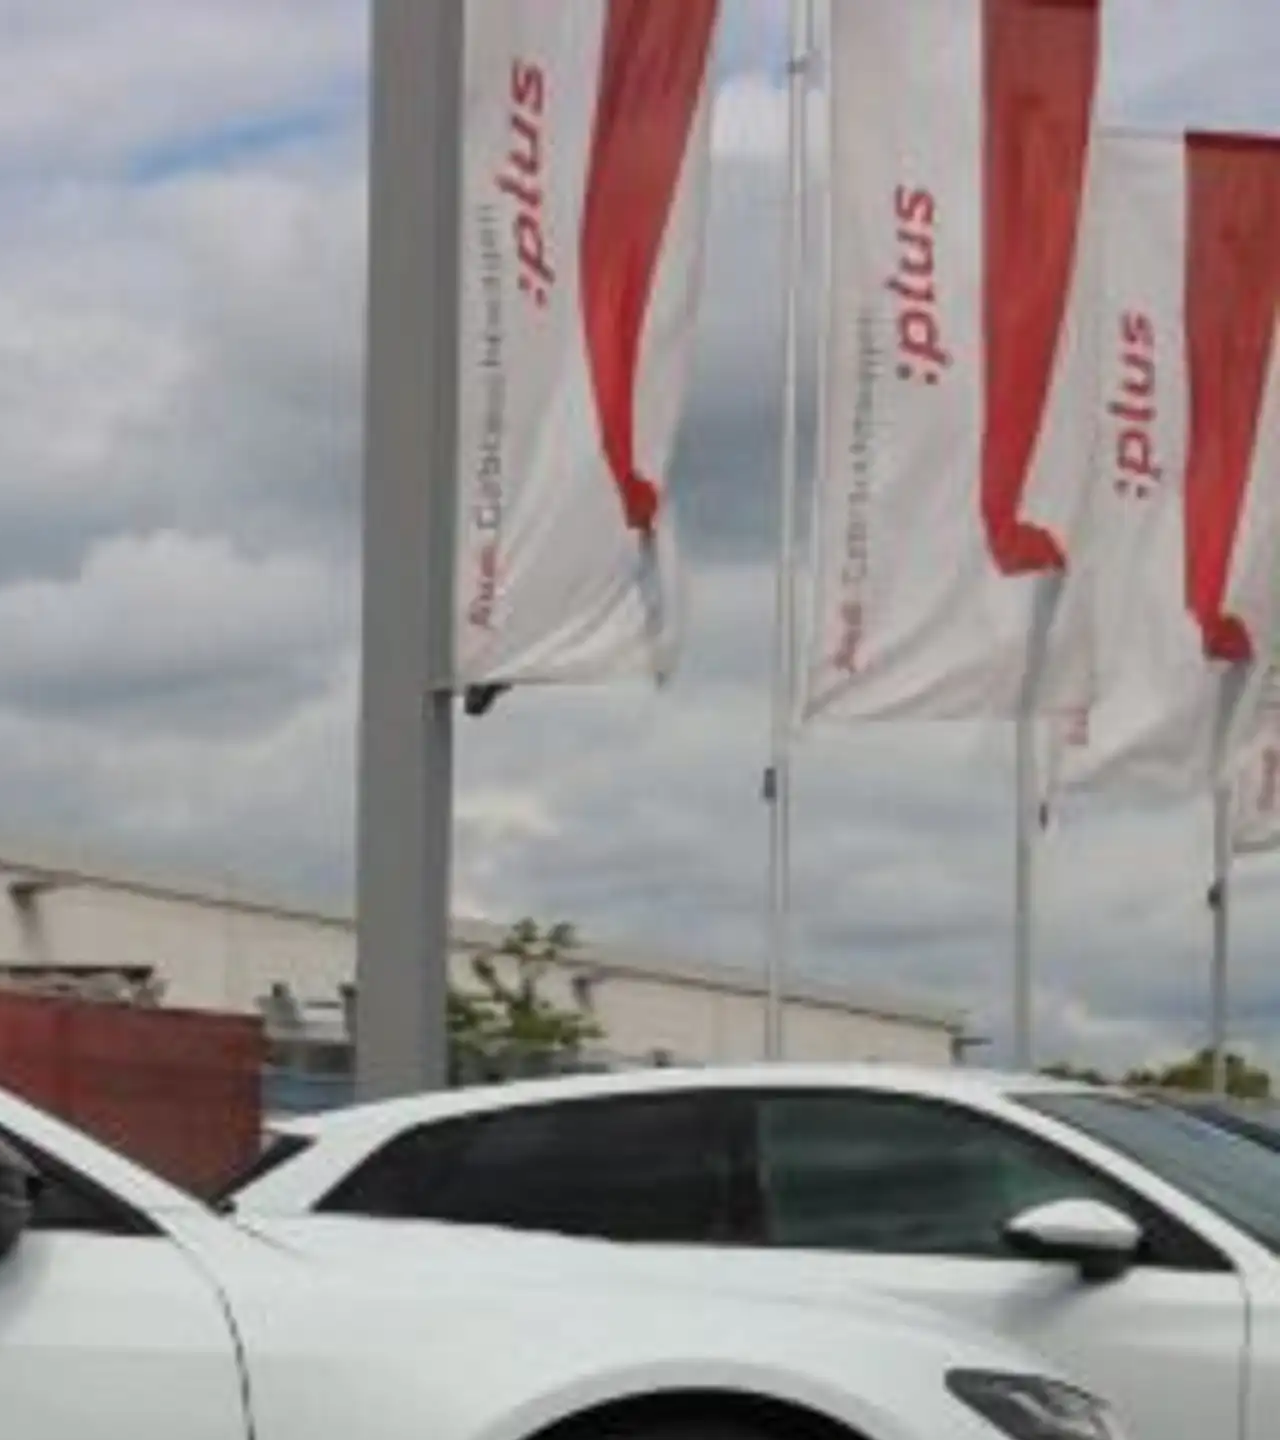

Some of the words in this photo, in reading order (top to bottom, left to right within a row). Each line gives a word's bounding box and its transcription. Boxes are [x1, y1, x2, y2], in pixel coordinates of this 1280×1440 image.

[494, 60, 555, 307] :plus
[885, 185, 953, 386] :plus
[1107, 310, 1162, 499] :plus
